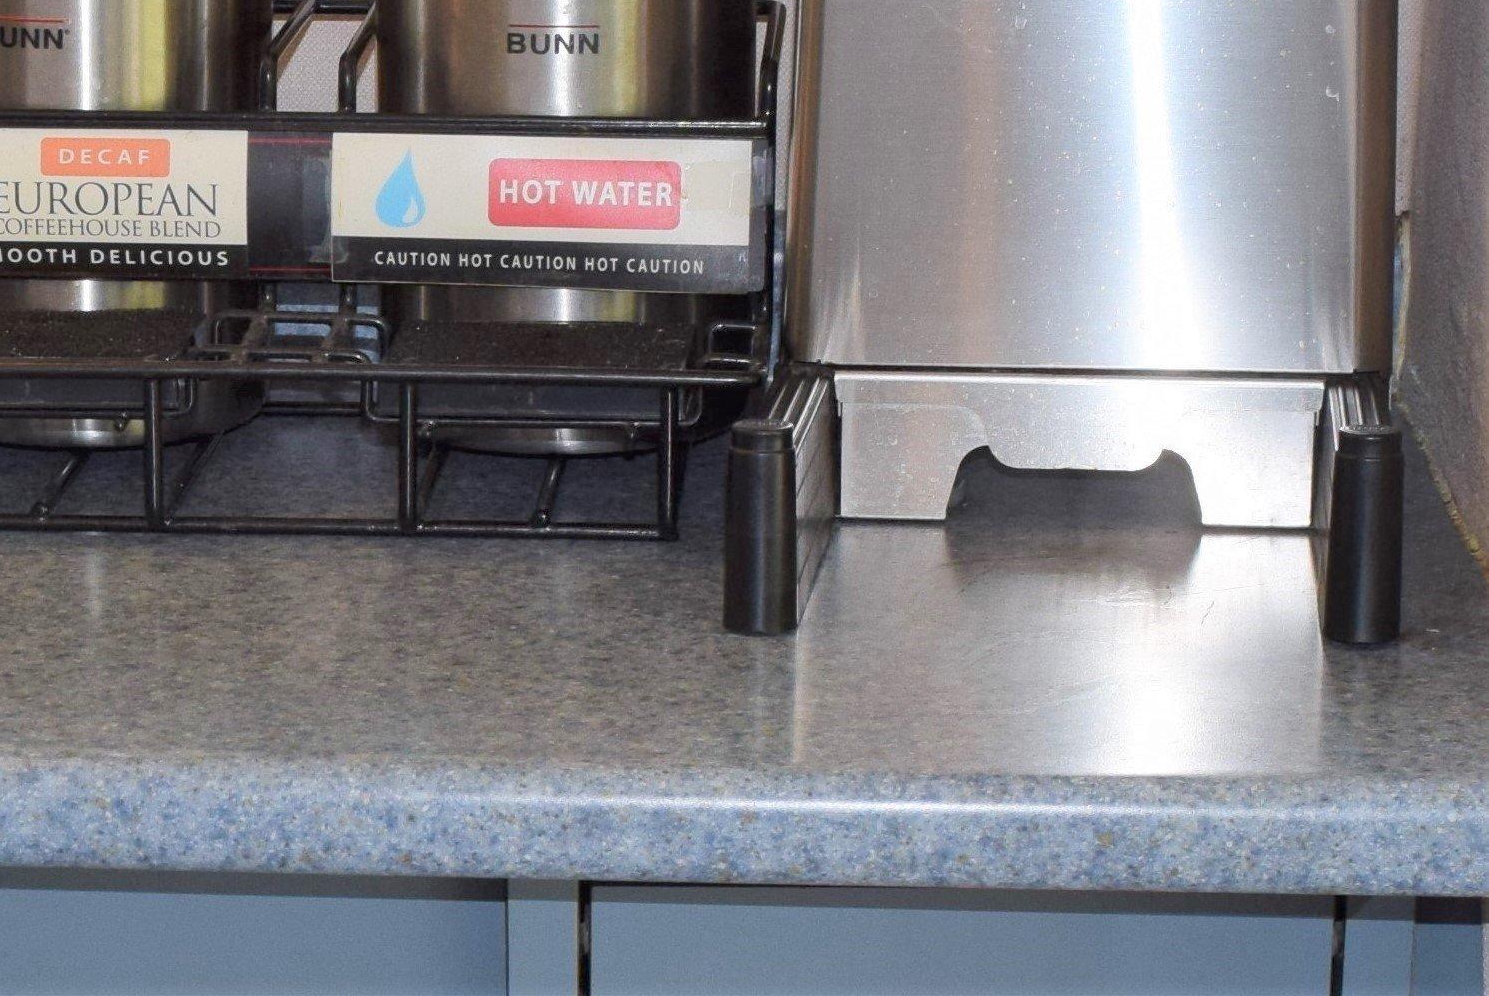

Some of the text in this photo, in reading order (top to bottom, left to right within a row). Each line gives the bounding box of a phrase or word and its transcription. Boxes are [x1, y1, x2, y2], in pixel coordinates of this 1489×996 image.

[507, 32, 600, 55] BUNN
[59, 148, 151, 165] DECAF
[499, 179, 673, 206] HOT WATER
[150, 220, 221, 239] BLEND
[90, 249, 229, 266] DELICIOUS
[374, 250, 704, 275] CAUTION HOT CAUTION HOT CAUTION
